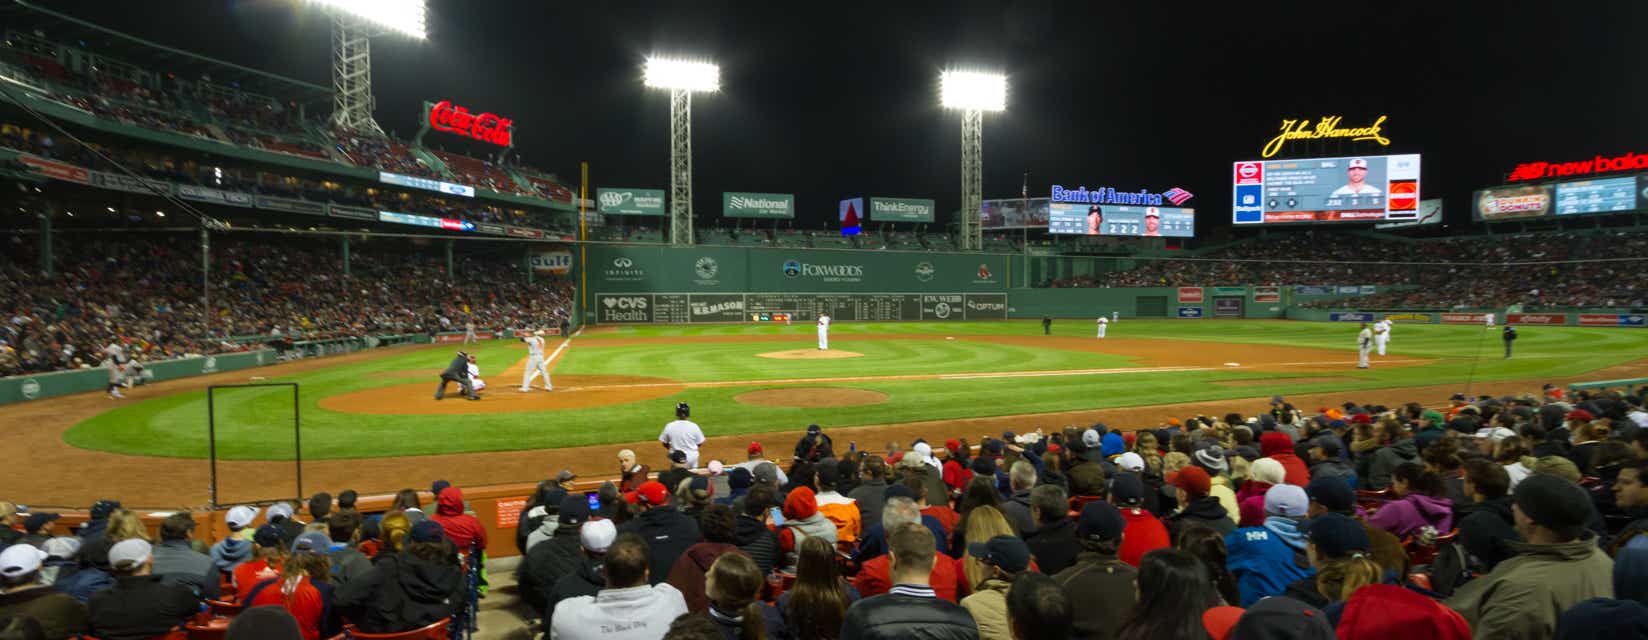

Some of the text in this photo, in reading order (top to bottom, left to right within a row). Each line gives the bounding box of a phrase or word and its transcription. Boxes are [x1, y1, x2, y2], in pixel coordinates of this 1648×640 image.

[1262, 116, 1390, 158] John Hancock
[1548, 160, 1593, 177] new
[1052, 185, 1163, 205] Bank of America
[743, 197, 788, 209] National
[618, 297, 647, 309] CVS
[605, 309, 647, 320] Health
